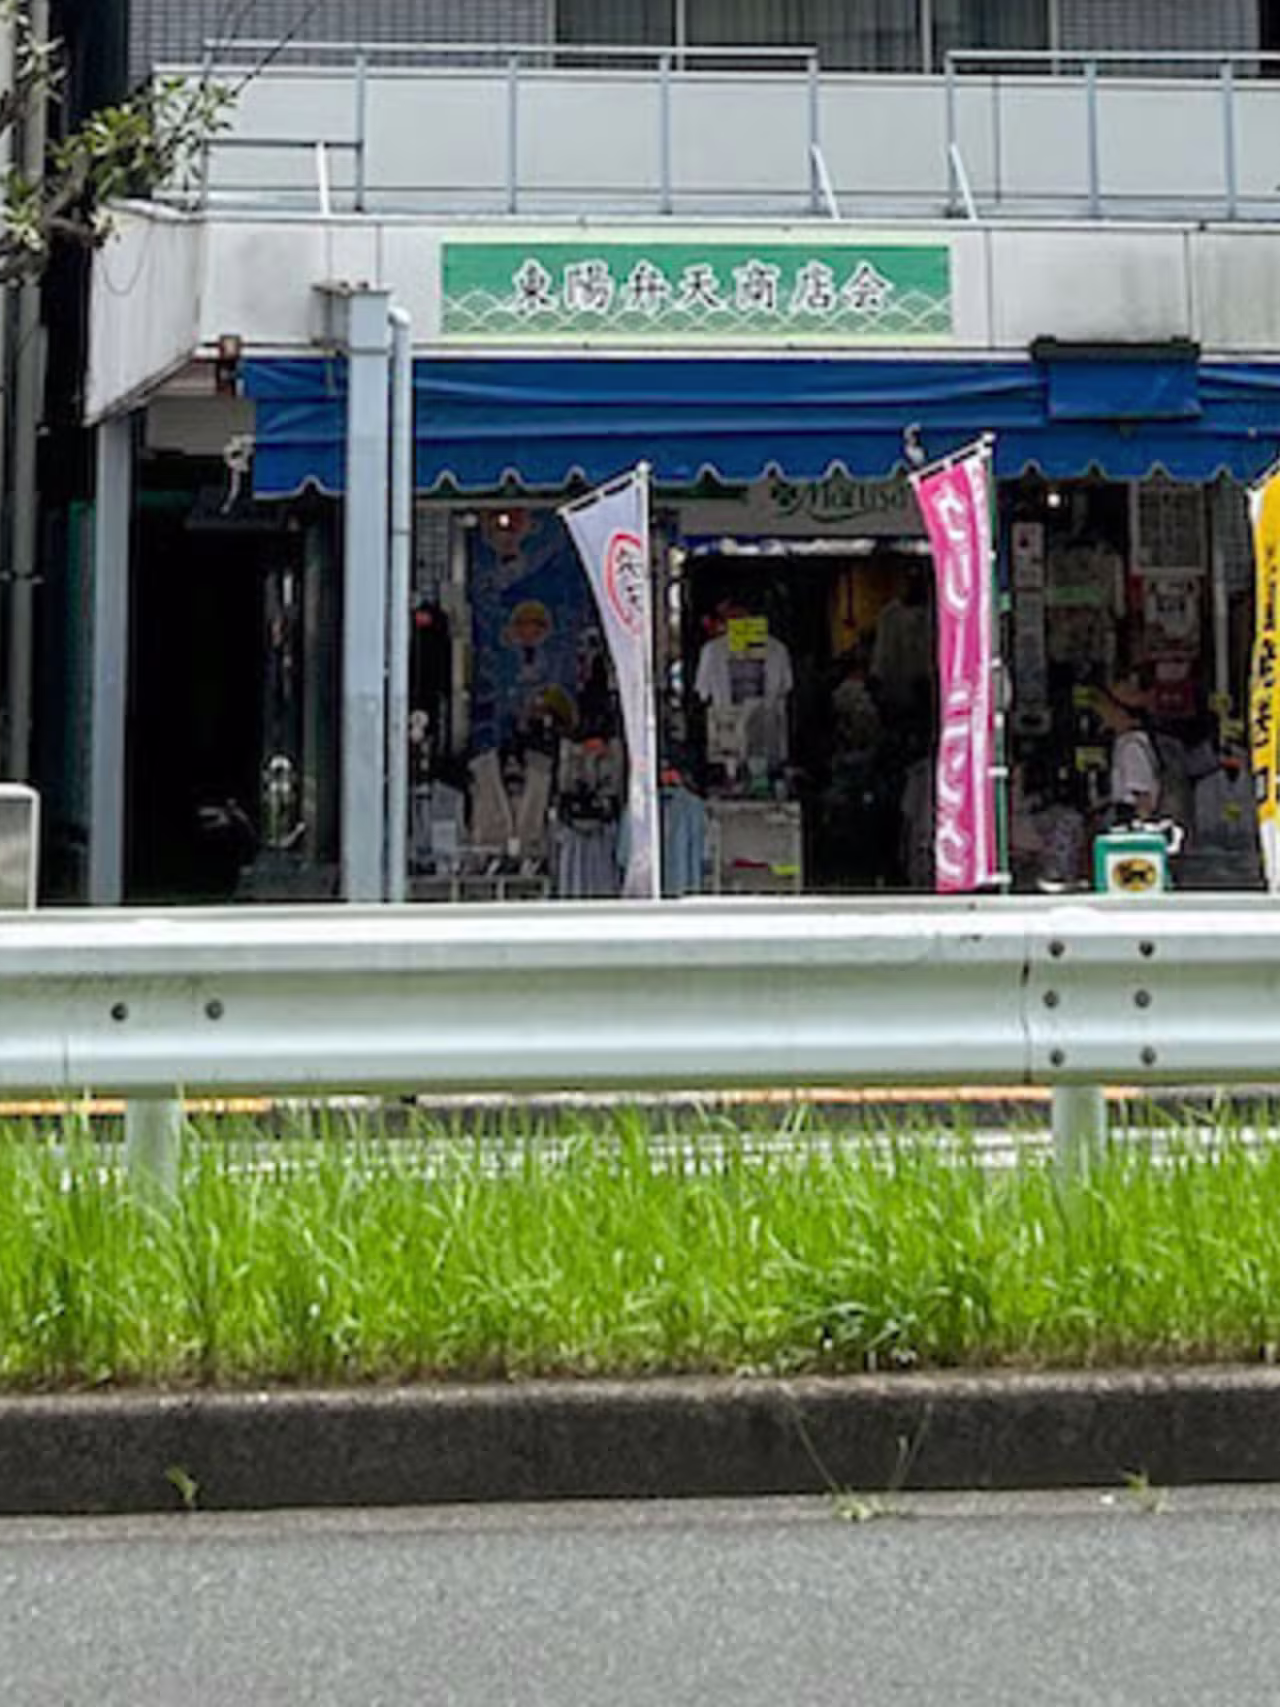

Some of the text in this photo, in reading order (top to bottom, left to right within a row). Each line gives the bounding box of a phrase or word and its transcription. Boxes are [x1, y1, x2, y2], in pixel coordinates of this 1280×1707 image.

[513, 258, 892, 317] 東陽弁天商店会
